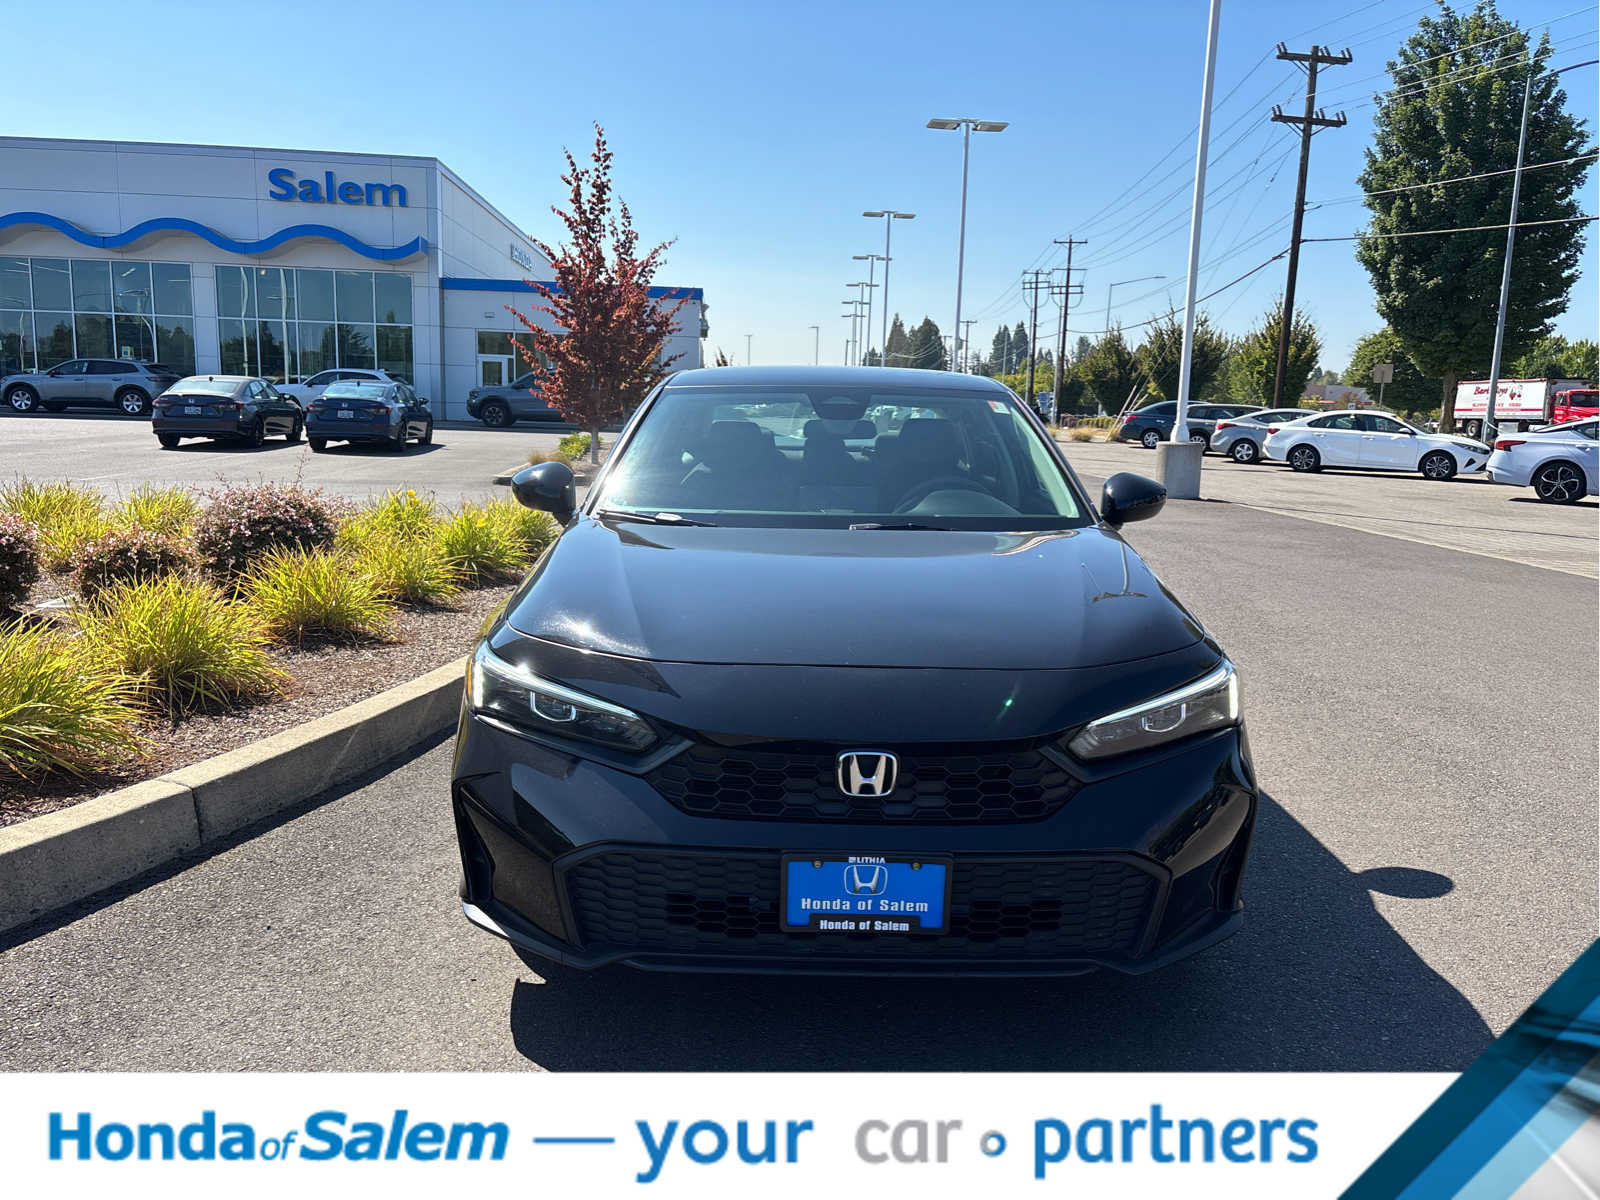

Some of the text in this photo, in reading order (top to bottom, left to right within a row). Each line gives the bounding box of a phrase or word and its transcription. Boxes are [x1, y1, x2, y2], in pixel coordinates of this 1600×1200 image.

[268, 168, 408, 207] Salem
[856, 856, 886, 864] LITHIA
[801, 898, 929, 913] Honda of Salem
[819, 919, 910, 932] Honda of Salem
